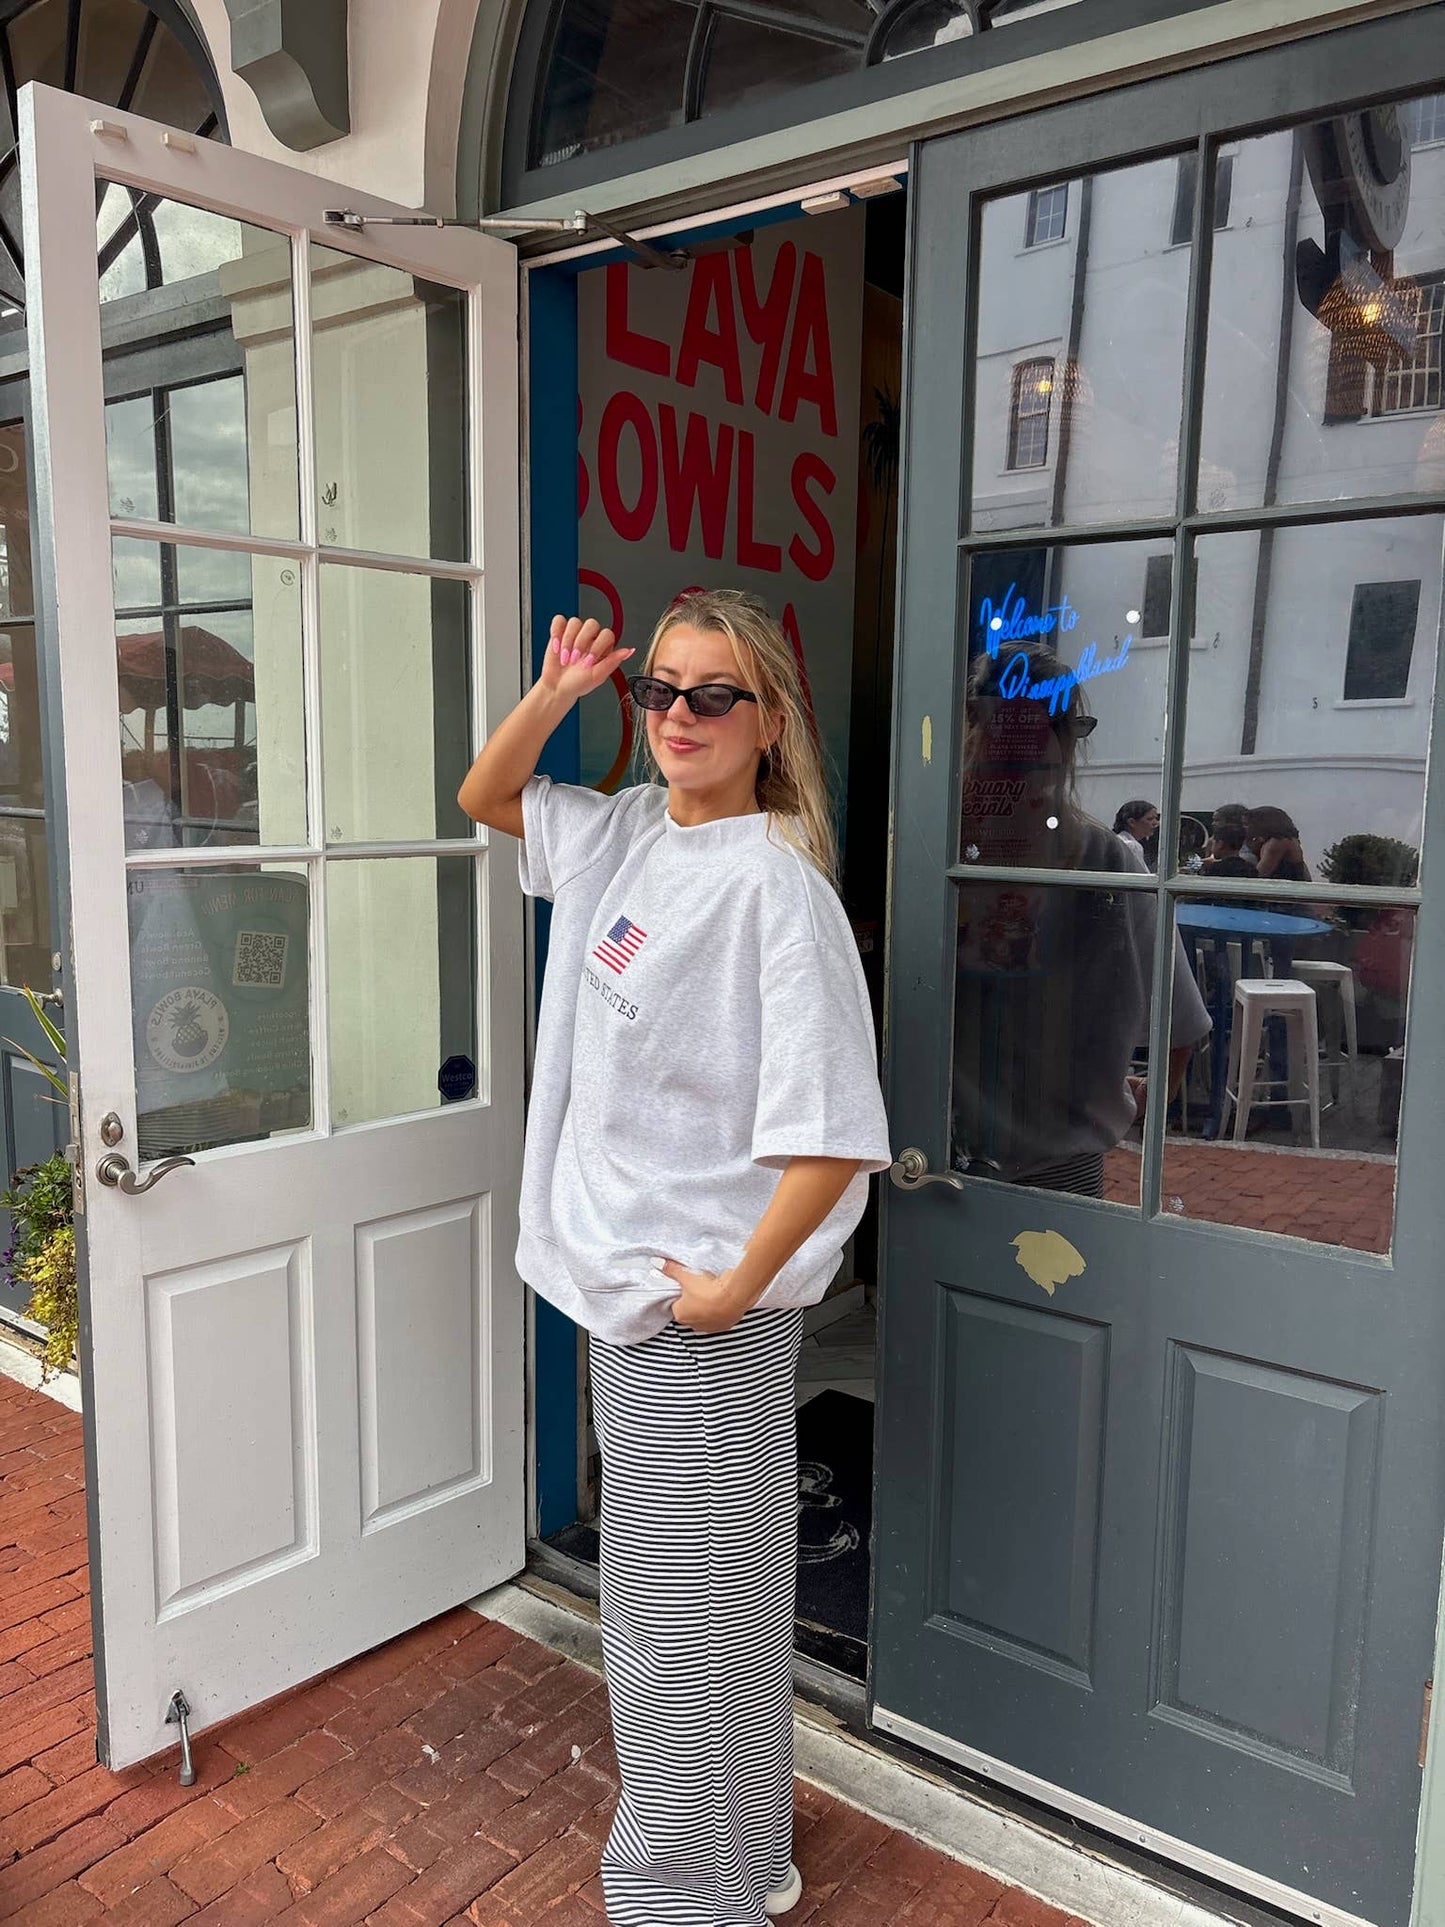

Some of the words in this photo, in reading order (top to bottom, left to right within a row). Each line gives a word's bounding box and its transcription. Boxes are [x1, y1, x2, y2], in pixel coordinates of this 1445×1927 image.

[606, 241, 838, 437] LAYA
[578, 391, 837, 582] OWLS
[980, 581, 1056, 660] Welcome
[1048, 594, 1080, 633] to
[963, 776, 1027, 802] bruary
[963, 796, 1015, 818] ecials
[584, 967, 600, 990] TED
[601, 982, 639, 1020] STATES
